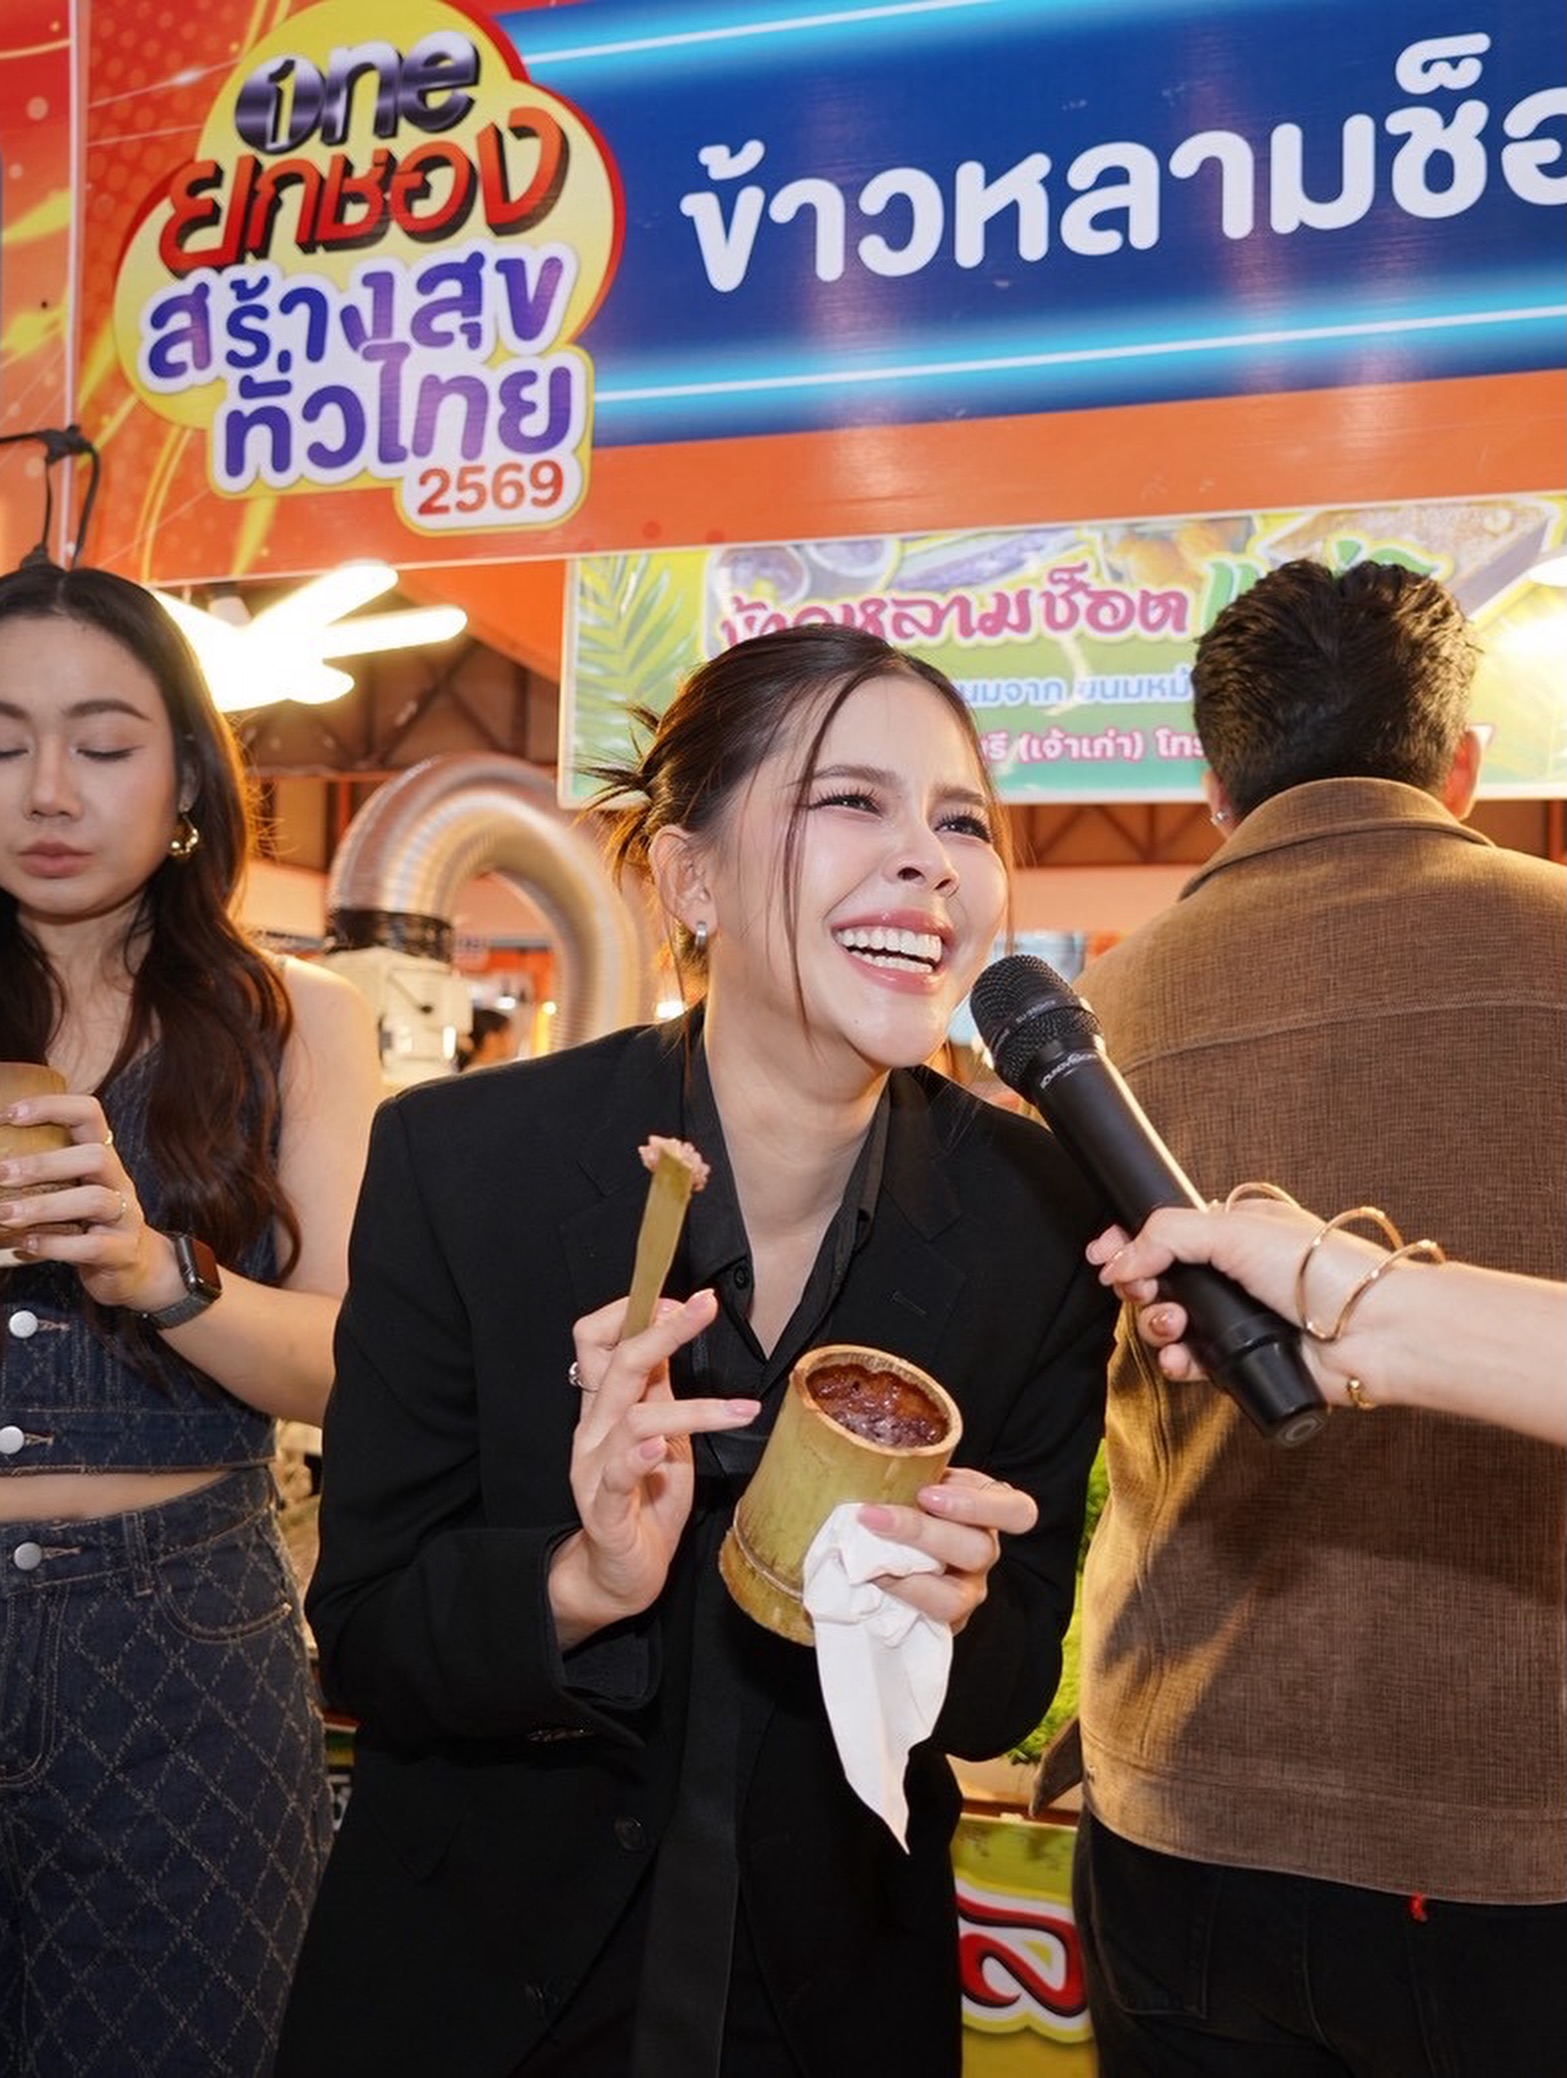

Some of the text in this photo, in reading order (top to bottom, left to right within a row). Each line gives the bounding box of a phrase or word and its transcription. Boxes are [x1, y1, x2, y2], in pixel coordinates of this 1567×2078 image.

[147, 251, 564, 380] สร้างสุข
[224, 342, 572, 478] ทั่วไทย
[416, 460, 564, 516] 2569
[958, 680, 1064, 703] นมจาก
[1018, 725, 1144, 763] (เจ้าเก่า)
